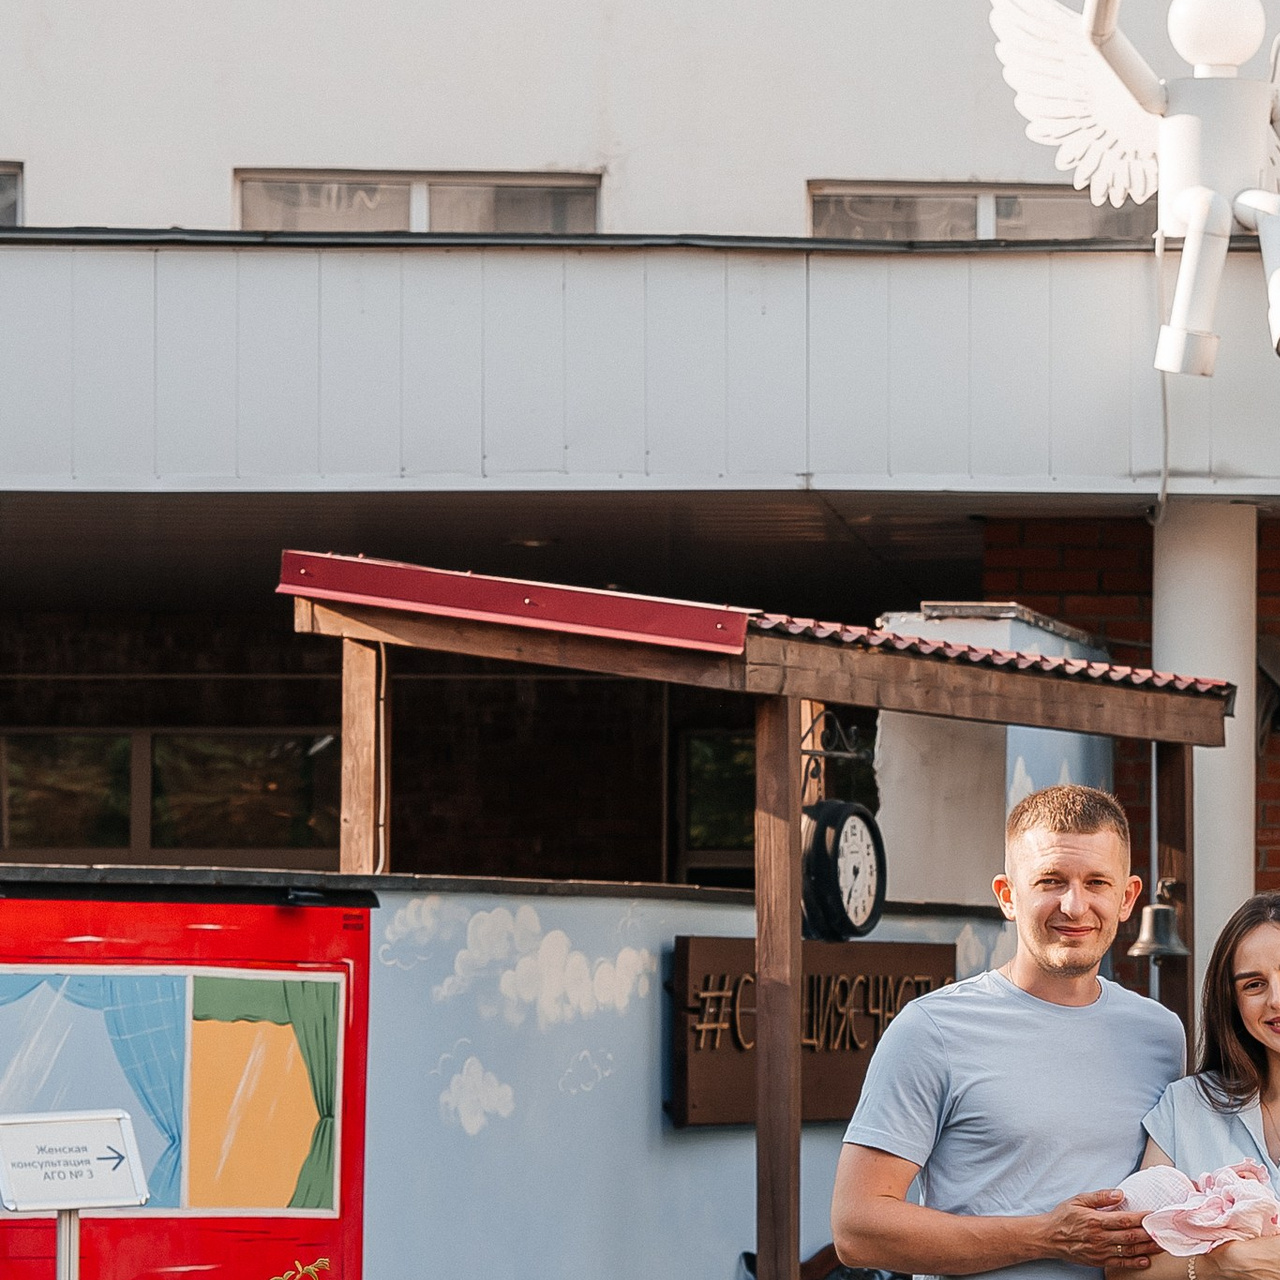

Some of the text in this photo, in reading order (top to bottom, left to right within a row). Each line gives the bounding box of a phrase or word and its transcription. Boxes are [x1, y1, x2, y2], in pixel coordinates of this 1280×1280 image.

[36, 1145, 88, 1154] Женская
[11, 1159, 91, 1170] консультация
[43, 1171, 66, 1180] АГО
[87, 1169, 94, 1179] 3
